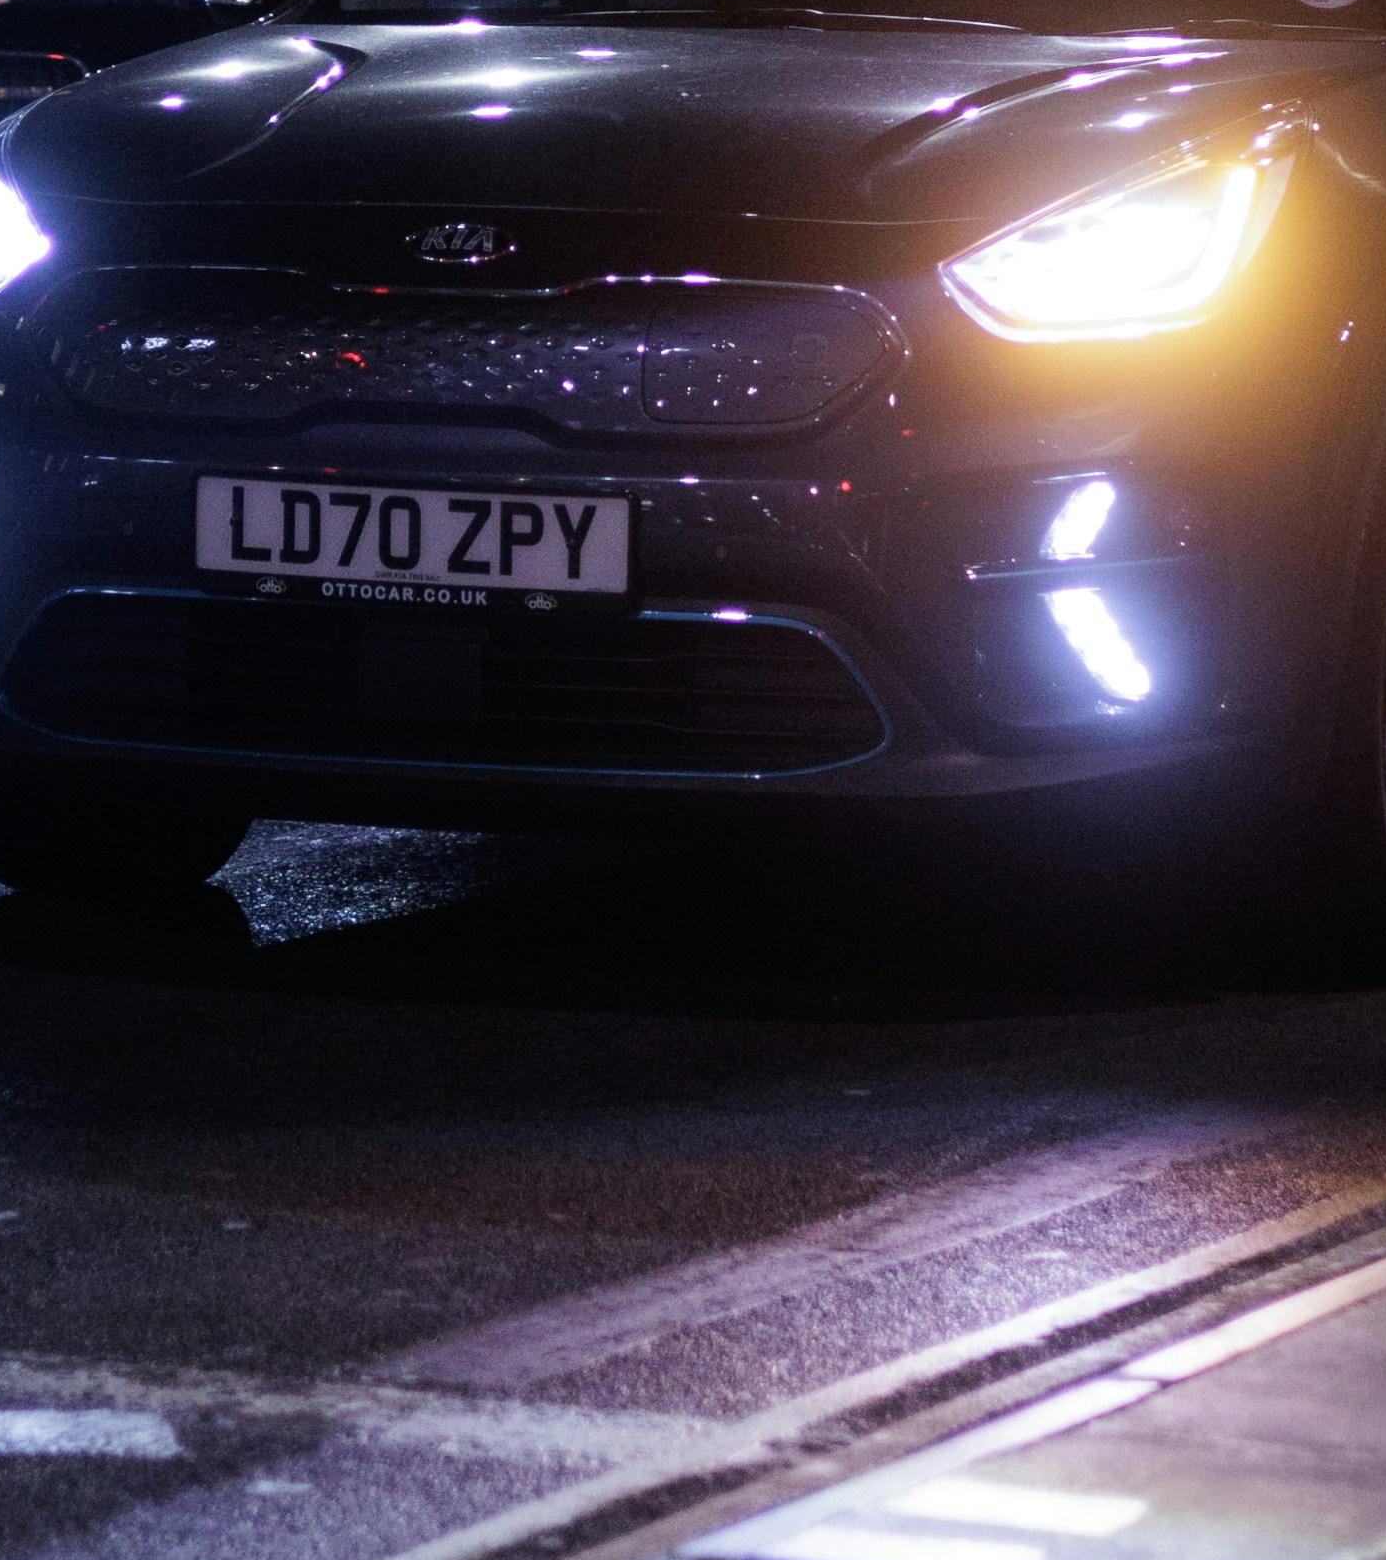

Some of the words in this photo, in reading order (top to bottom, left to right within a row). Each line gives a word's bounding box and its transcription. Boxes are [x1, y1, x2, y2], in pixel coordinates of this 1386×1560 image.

[230, 486, 421, 571] LD70
[446, 498, 598, 580] ZPY
[321, 581, 488, 606] OTTOCAR.CO.UK
